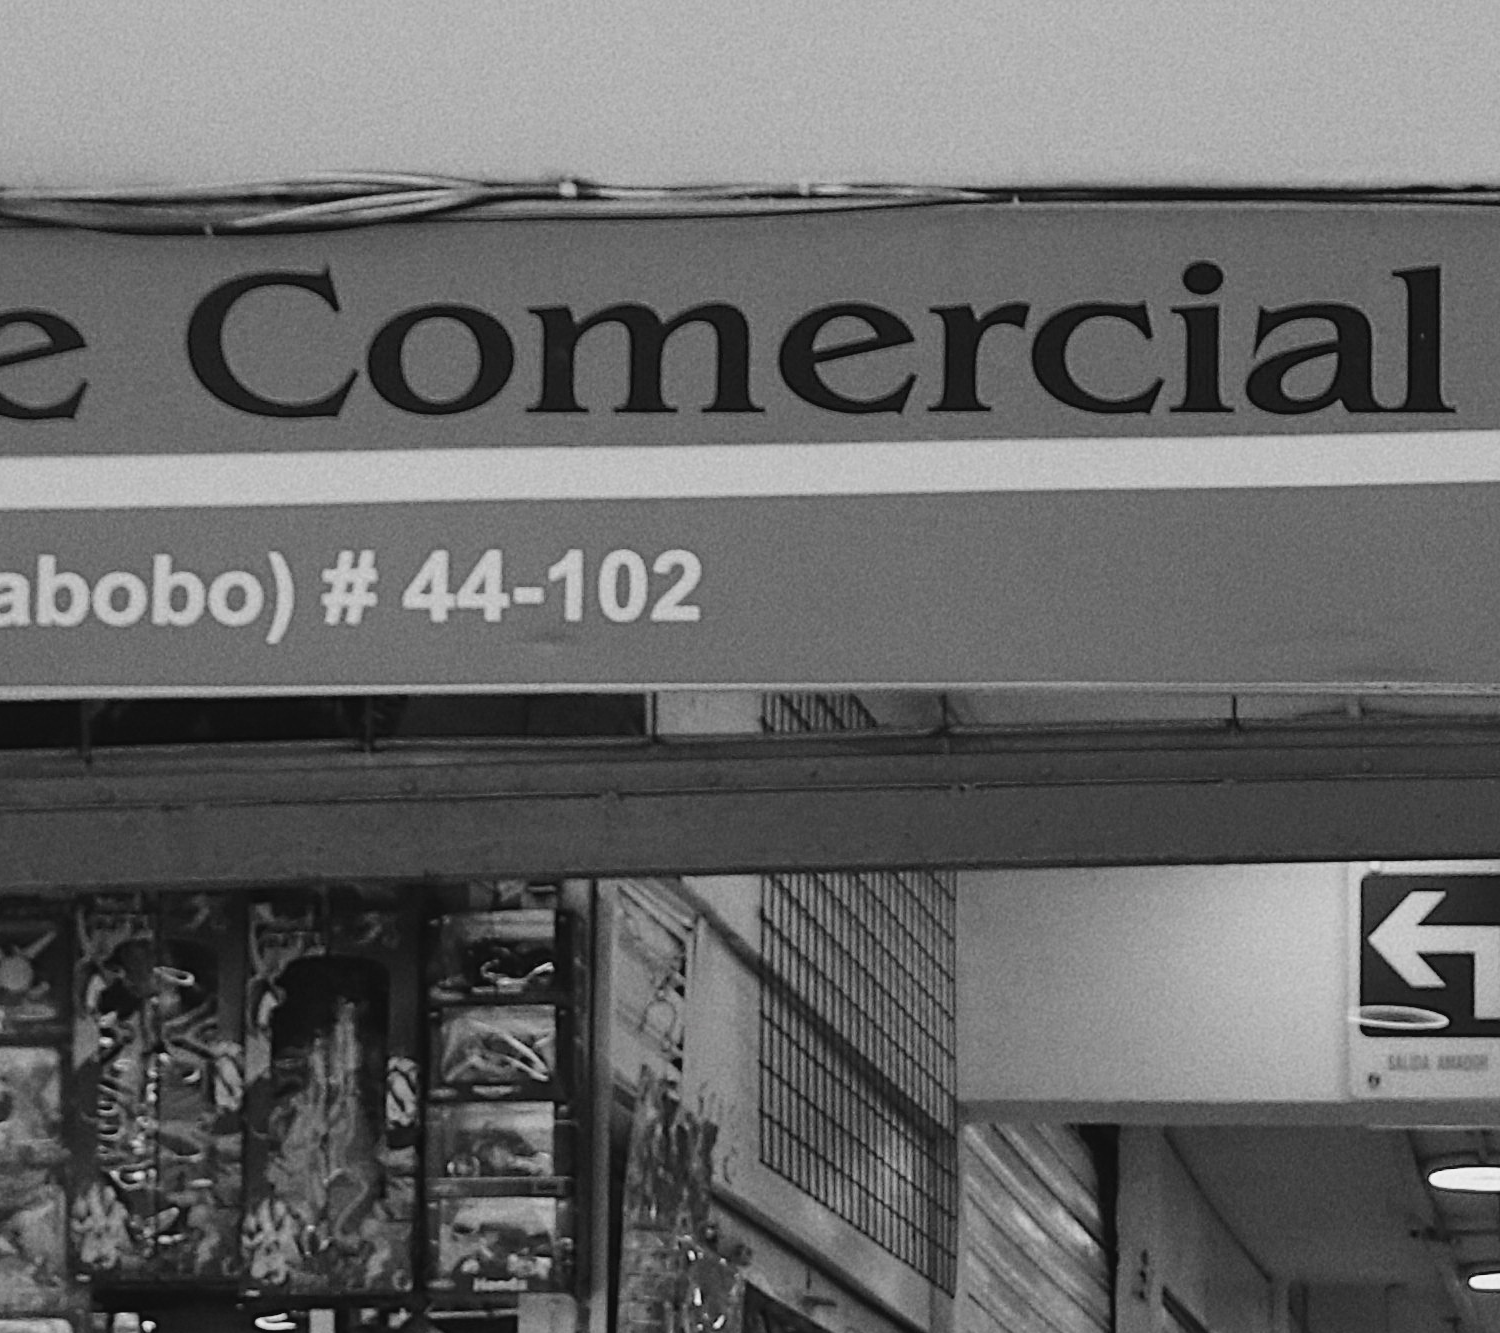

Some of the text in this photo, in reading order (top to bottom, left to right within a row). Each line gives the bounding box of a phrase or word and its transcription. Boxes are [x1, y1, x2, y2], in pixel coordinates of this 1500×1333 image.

[184, 259, 1458, 419] Comercial
[321, 551, 378, 623] #
[402, 548, 702, 623] 44-102
[1387, 1054, 1489, 1072] SALIDA AMADOR
